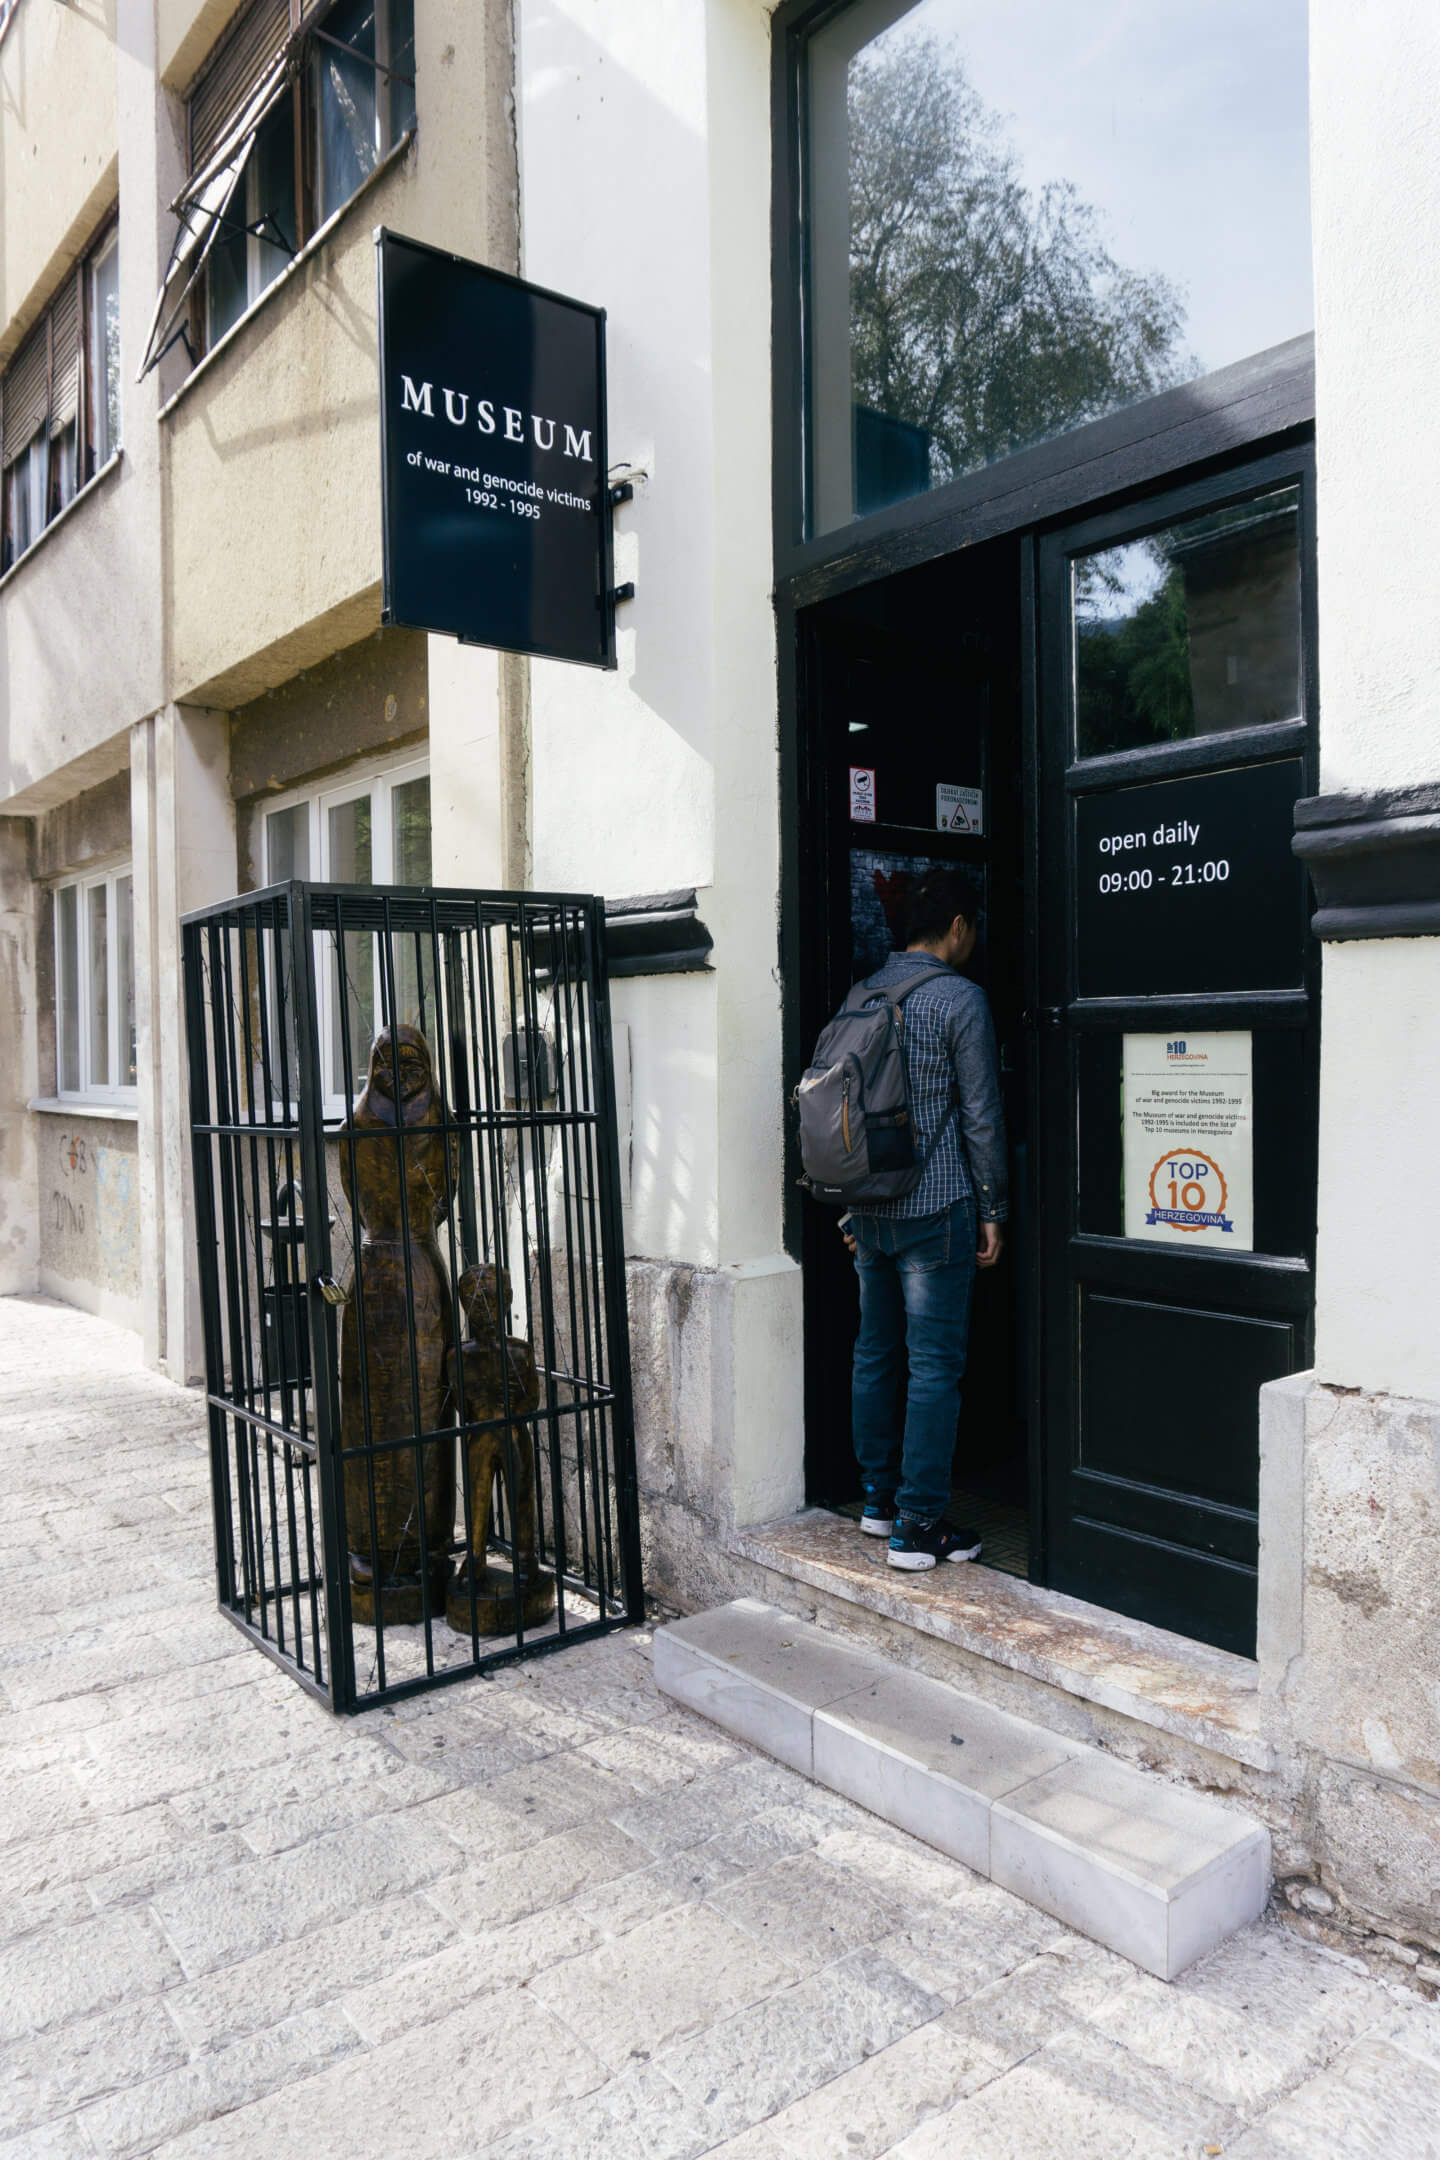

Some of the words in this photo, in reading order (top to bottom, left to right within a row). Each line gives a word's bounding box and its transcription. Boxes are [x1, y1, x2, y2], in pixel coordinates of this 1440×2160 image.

[401, 374, 593, 462] MUSEUM
[407, 451, 423, 466] of
[425, 457, 451, 475] war
[453, 464, 480, 483] and
[483, 472, 544, 499] genocide
[546, 489, 592, 511] victims
[465, 487, 498, 510] 1992
[510, 499, 541, 520] 1995
[1099, 832, 1147, 856] open
[1152, 820, 1200, 846] daily
[1099, 868, 1153, 894] 09:00
[1171, 859, 1230, 886] 21:00
[1167, 1161, 1209, 1180] TOP
[1167, 1180, 1206, 1211] 10
[1154, 1210, 1224, 1225] HERZEGOVINA
